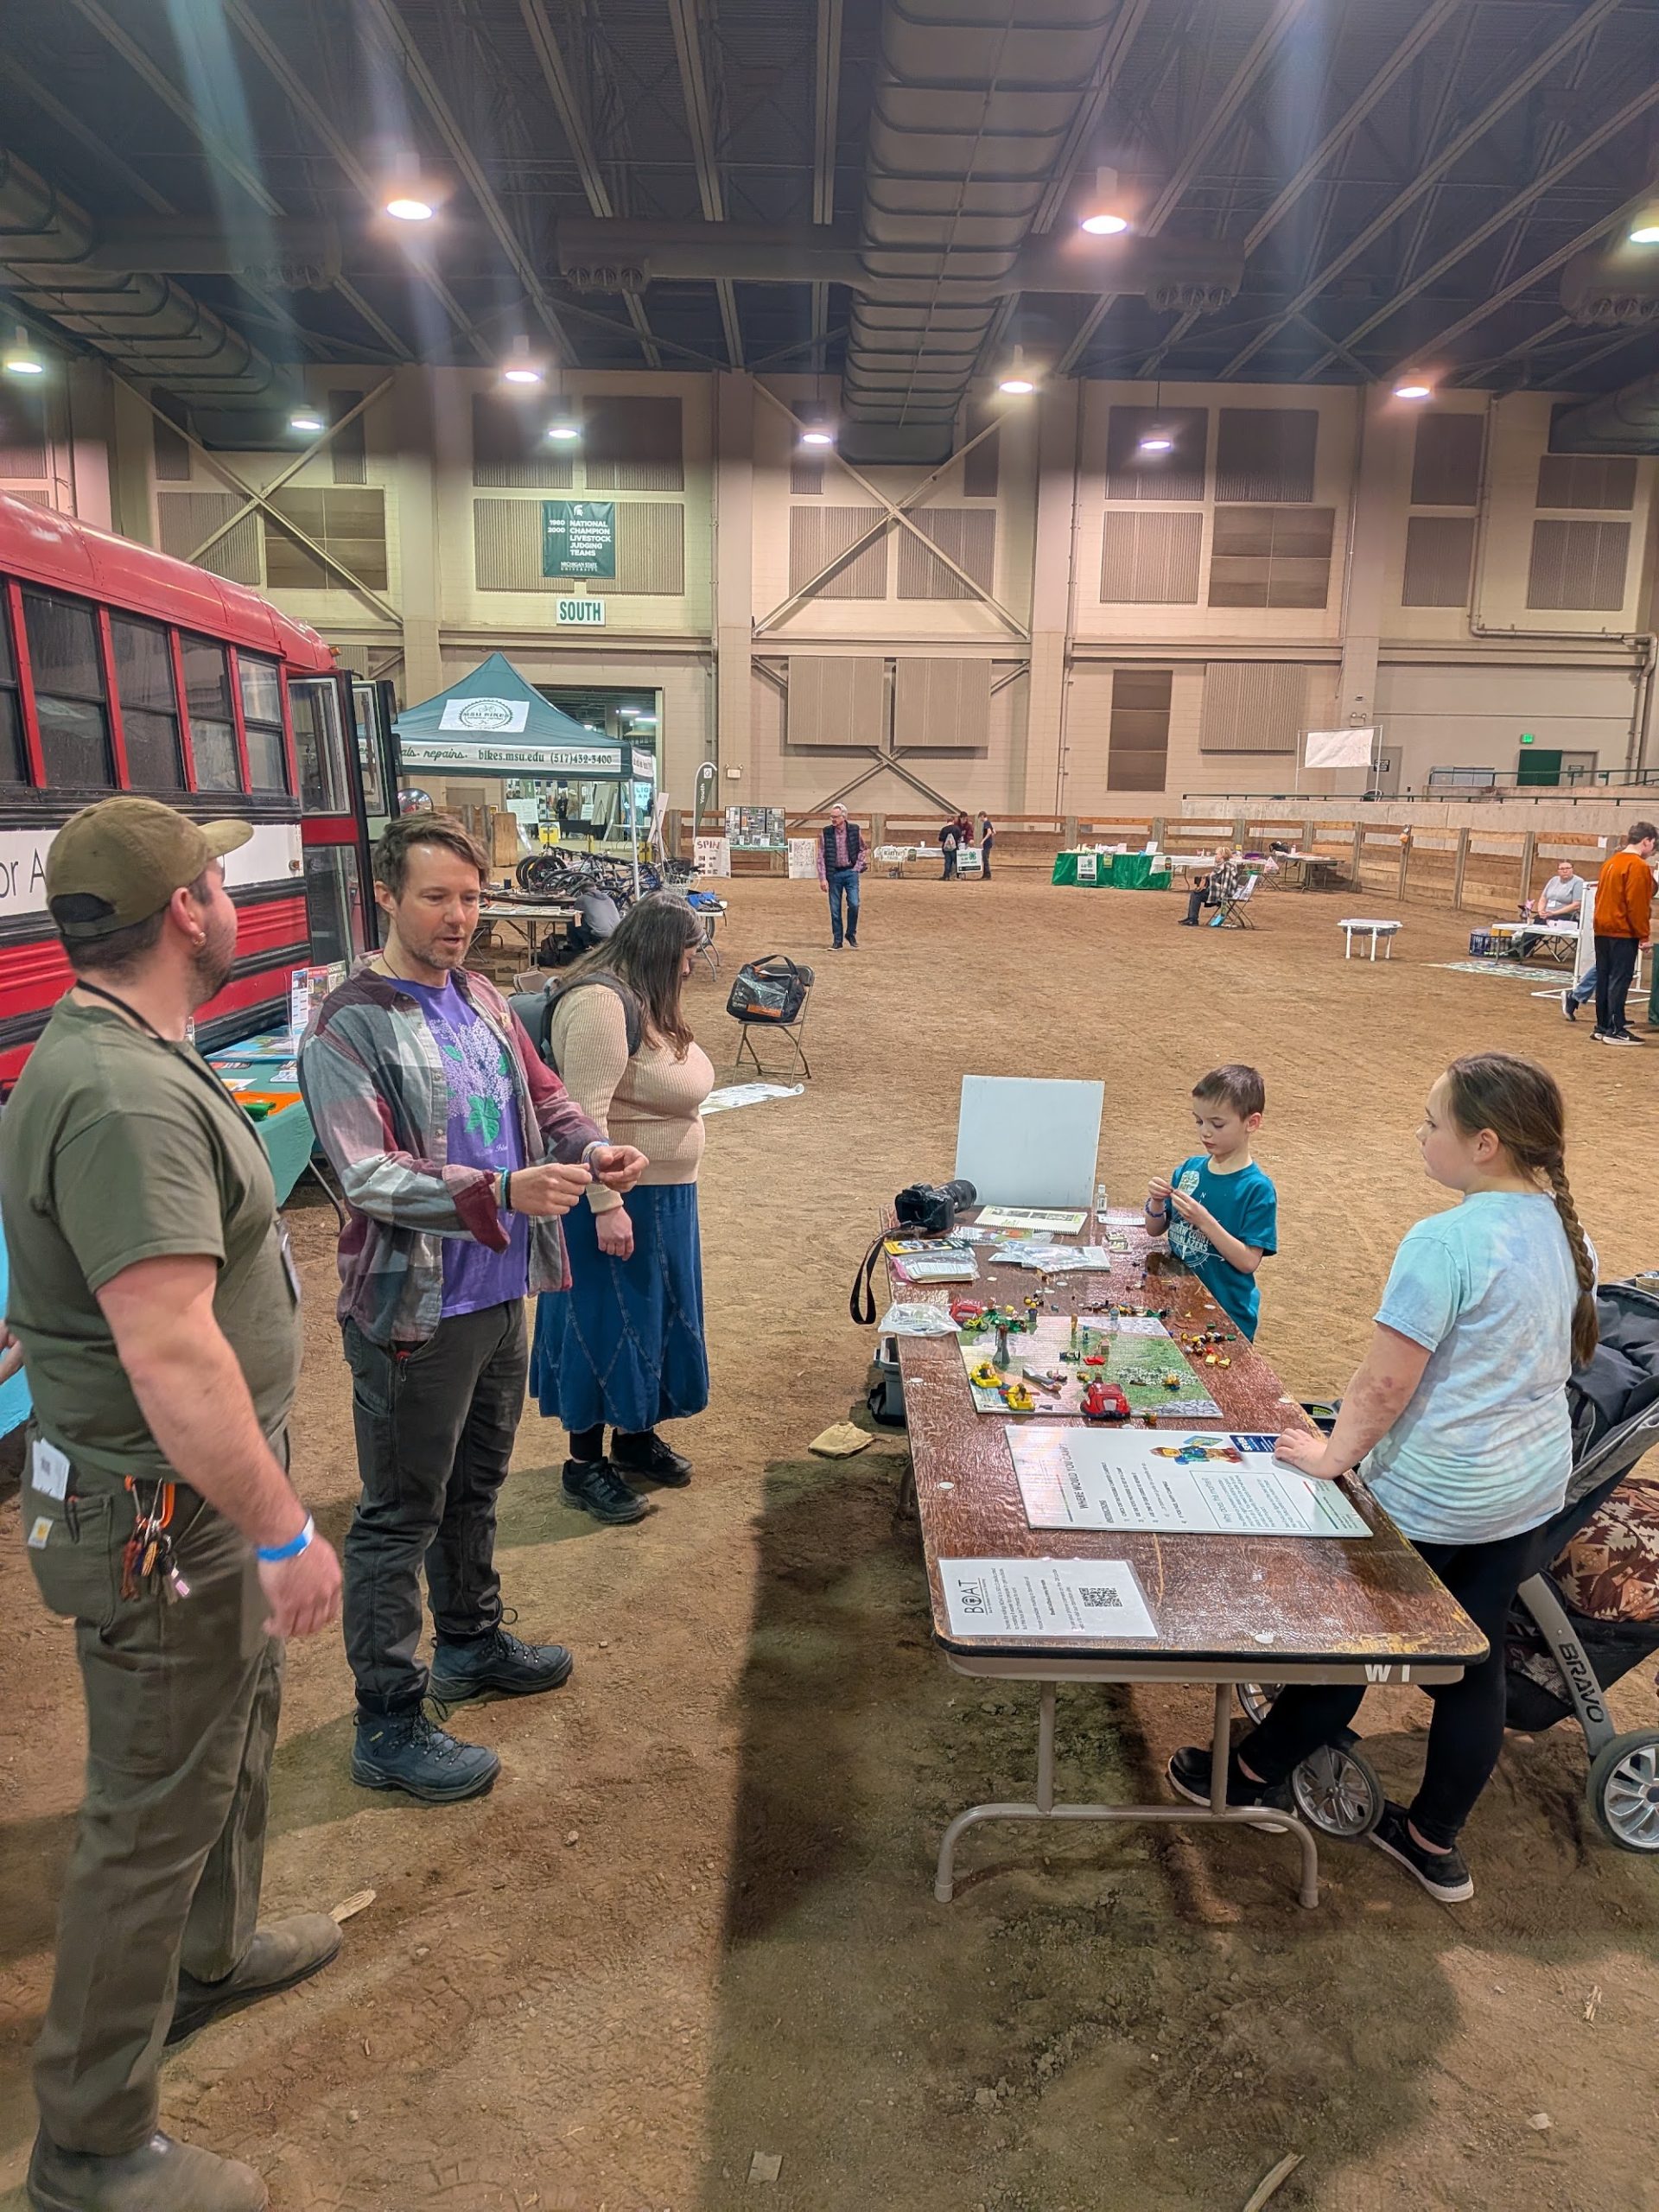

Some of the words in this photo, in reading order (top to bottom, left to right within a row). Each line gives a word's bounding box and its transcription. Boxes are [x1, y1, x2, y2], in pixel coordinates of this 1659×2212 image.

[560, 601, 601, 621] SOUTH
[423, 748, 468, 761] repairs.
[479, 749, 544, 762] bikes.msu.edu
[550, 752, 612, 765] (517)432-3400
[1063, 1460, 1075, 1471] YOU
[1067, 1472, 1082, 1490] WOULD
[1074, 1491, 1089, 1509] WHERE
[957, 1580, 985, 1614] BOAT
[1558, 1643, 1604, 1723] BRAVO
